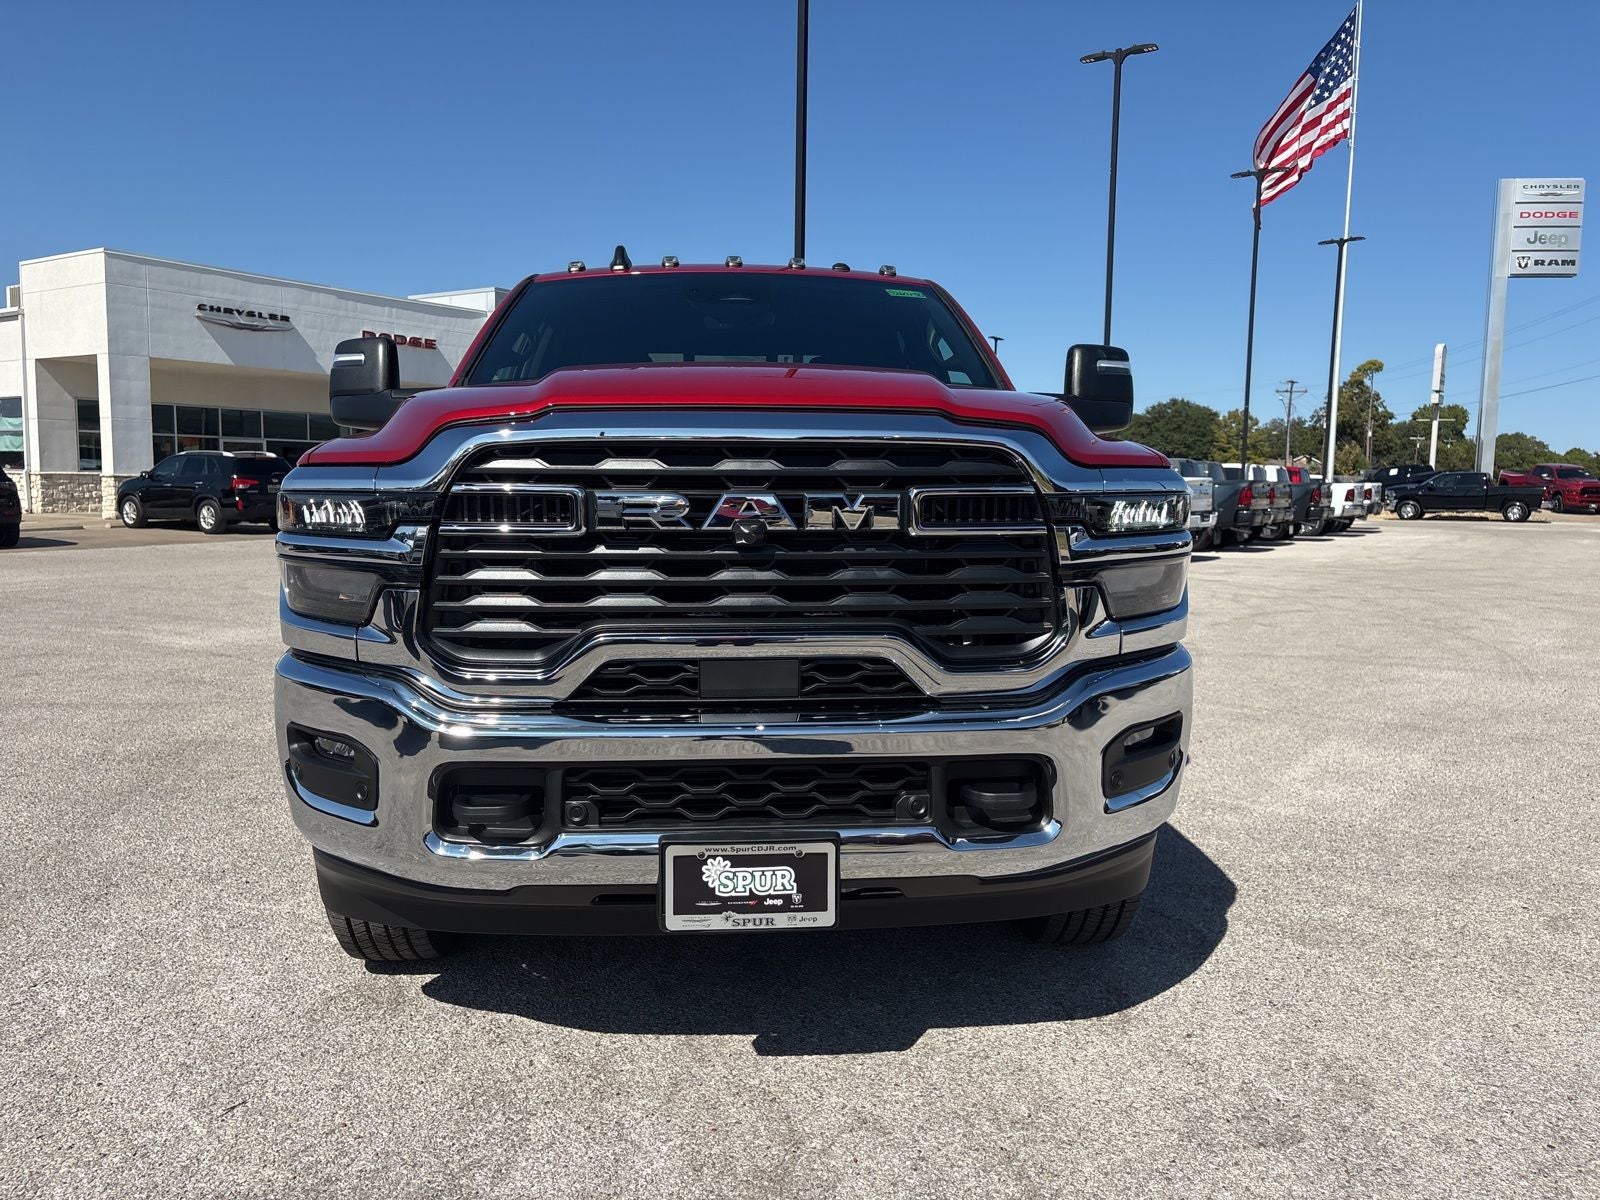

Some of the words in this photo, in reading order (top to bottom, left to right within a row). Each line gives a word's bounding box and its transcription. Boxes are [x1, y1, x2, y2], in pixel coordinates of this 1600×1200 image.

[1519, 211, 1579, 219] DODGE
[1526, 231, 1568, 247] Jeep
[1533, 259, 1576, 267] RAM
[196, 303, 290, 322] CHRYSLER
[594, 490, 900, 531] RAM
[704, 845, 797, 854] www.SpurCDJR.com
[718, 869, 795, 894] SPUR
[763, 898, 783, 906] Jeep
[732, 917, 777, 927] SPUR
[799, 915, 818, 923] Jeep
